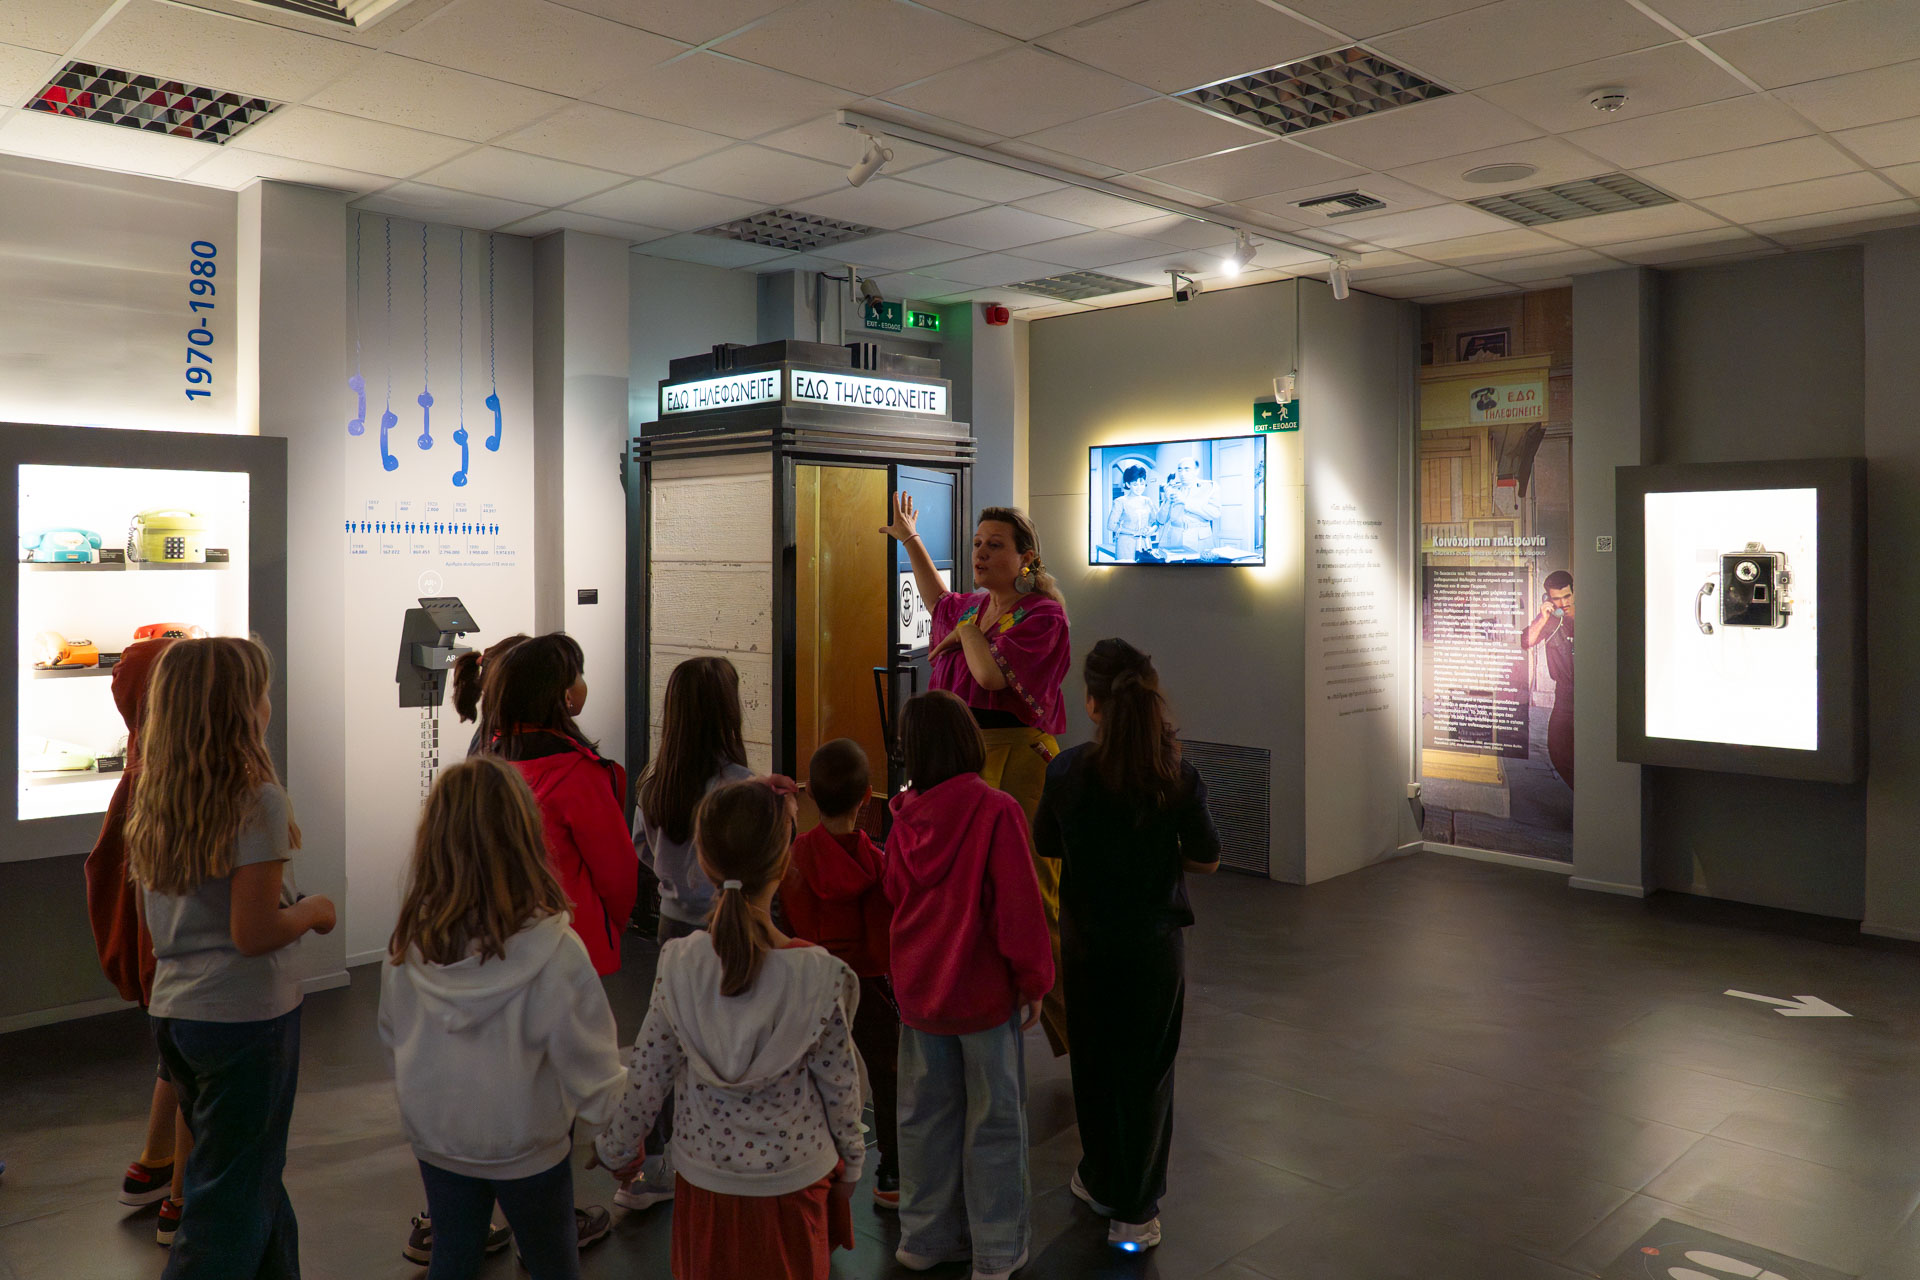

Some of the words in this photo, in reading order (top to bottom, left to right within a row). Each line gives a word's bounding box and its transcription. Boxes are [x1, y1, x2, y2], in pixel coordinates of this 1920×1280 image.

[185, 240, 217, 401] 1970-1980
[881, 322, 901, 331] ΕΞΟΔΟΣ
[668, 390, 689, 411] ΕΔΩ
[693, 377, 774, 407] ΤΗΛΕΦΩΝΕΙΤΕ
[796, 377, 829, 400] ΕΔΩ
[835, 381, 936, 410] ΤΗΛΕΦΩΝΕΙΤΕ
[1507, 389, 1535, 403] ΕΔΩ
[1485, 405, 1542, 420] ΤΗΛΕΦΩΝΕΙΤΕ
[1273, 422, 1297, 430] ΕΞΟΔΟΣ
[1432, 535, 1490, 547] Κοινόχρηστη
[1492, 535, 1545, 548] τηλεφωνία
